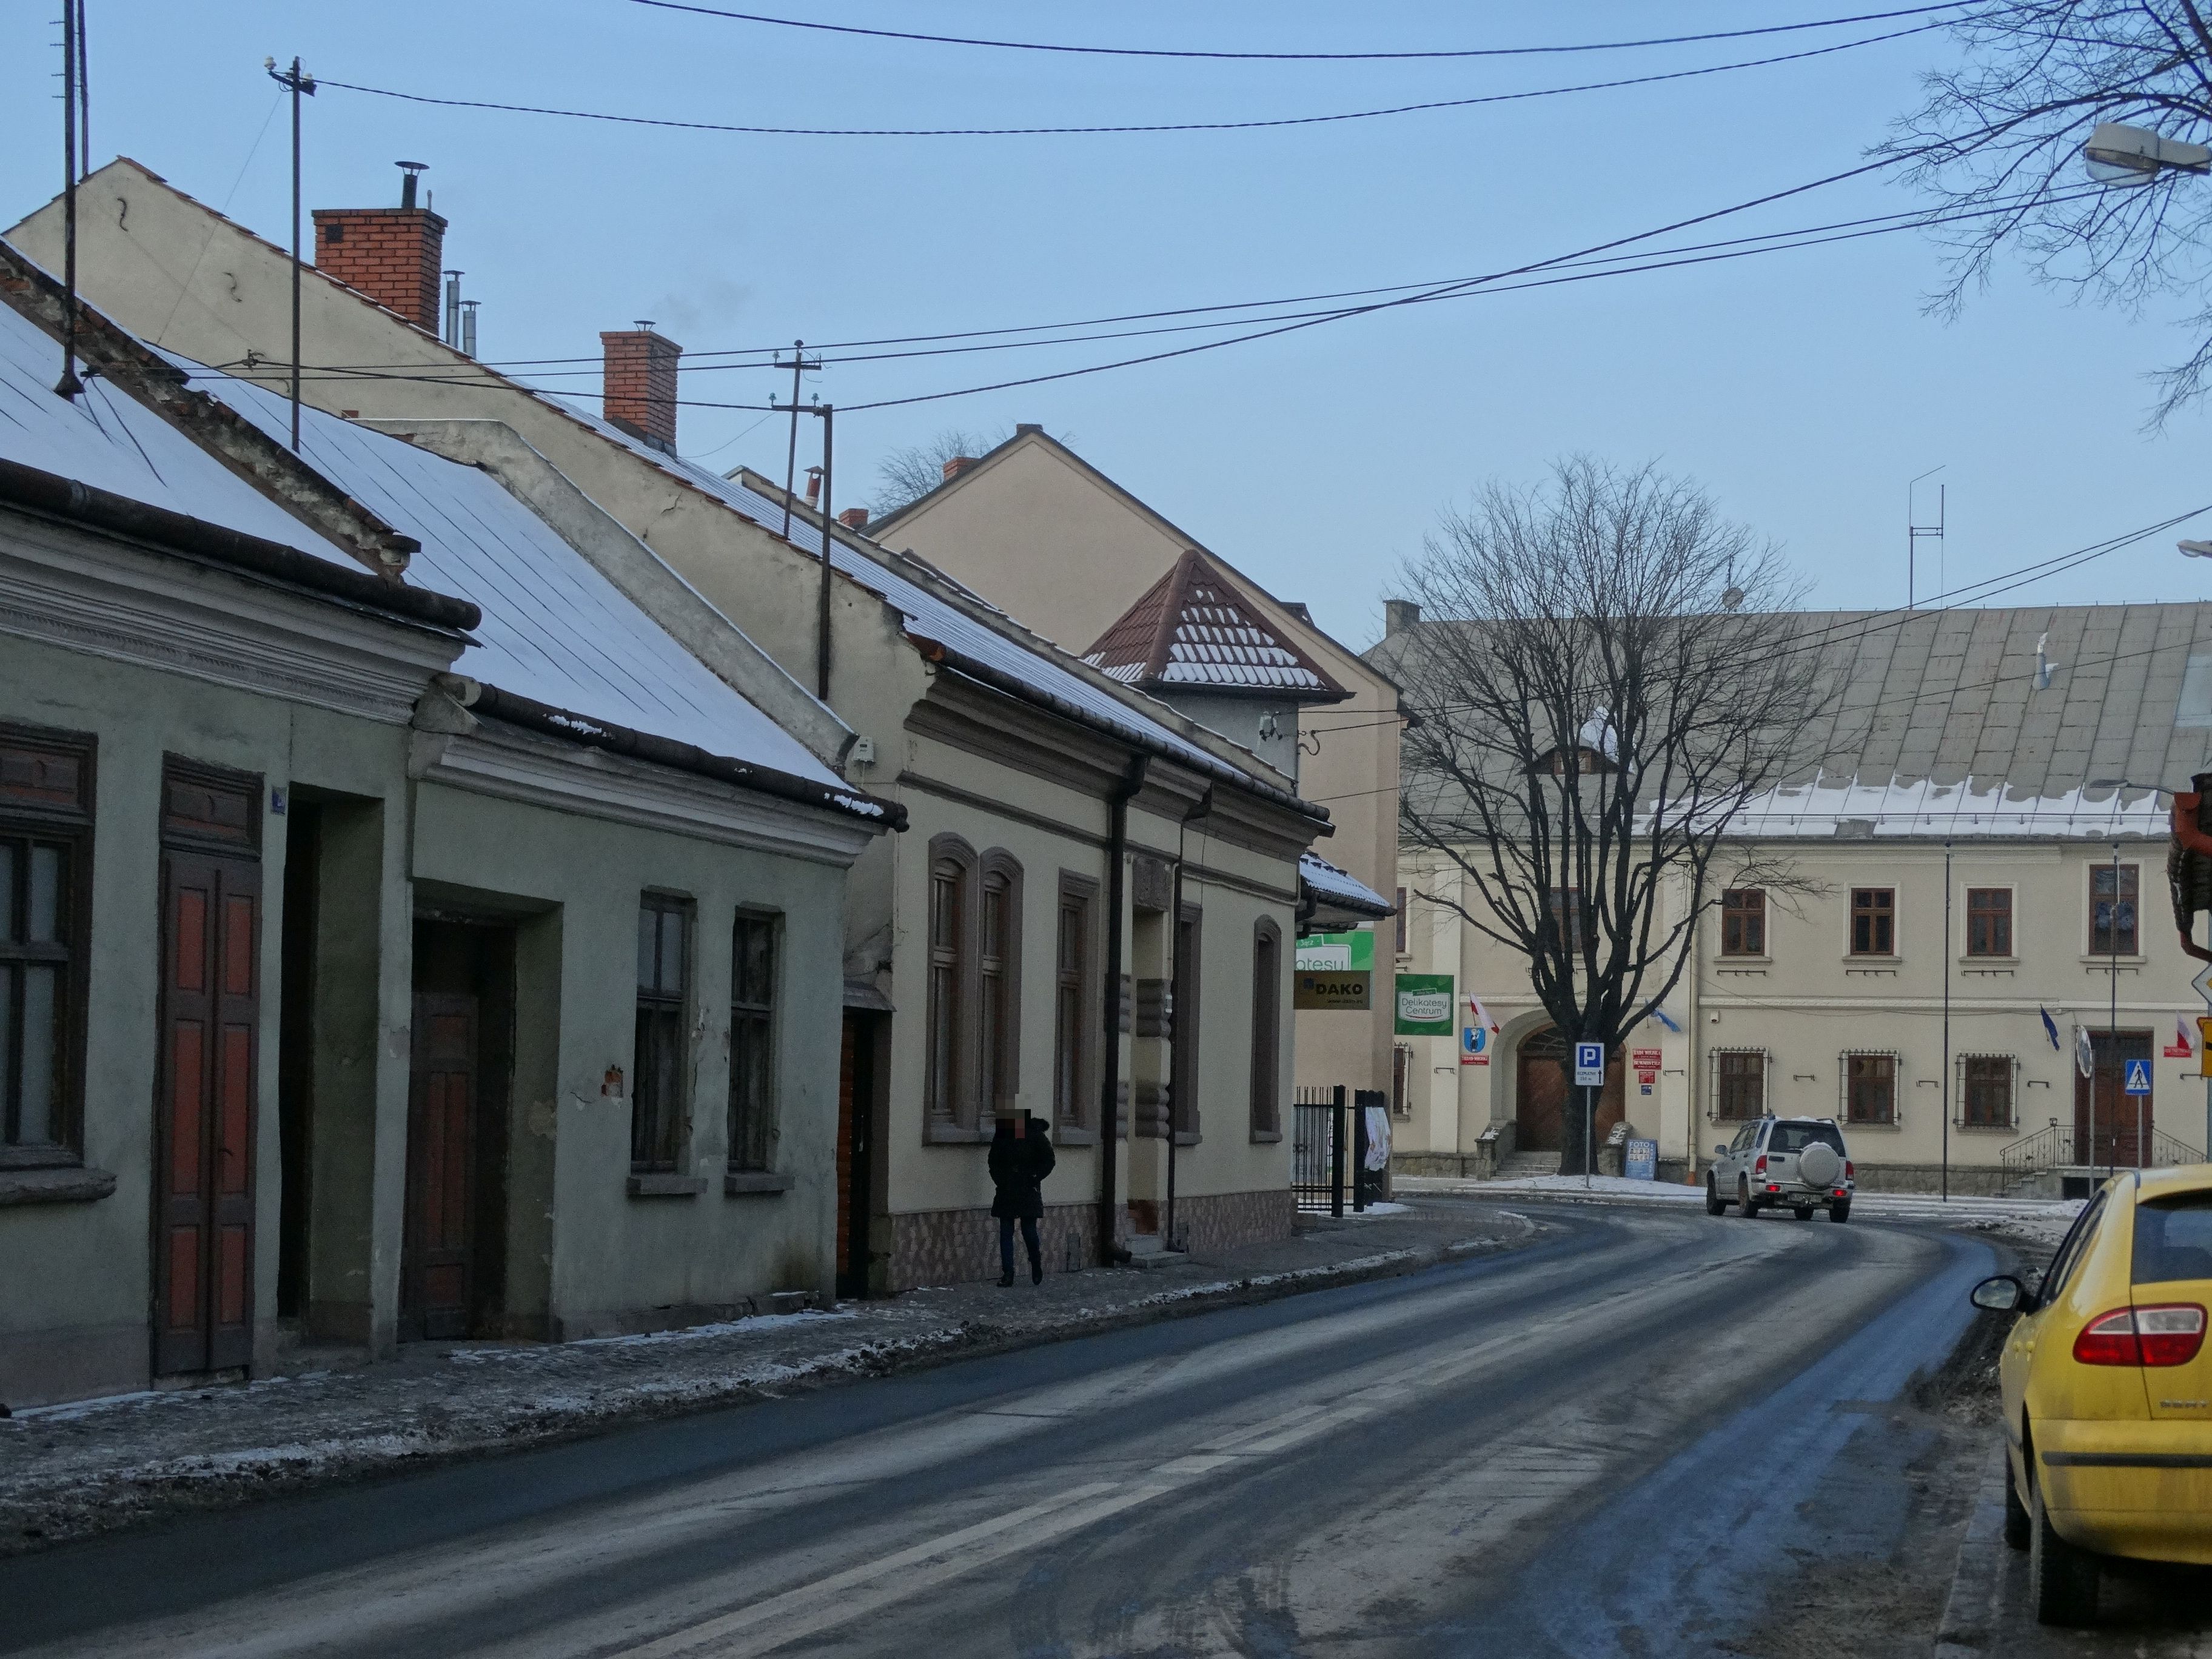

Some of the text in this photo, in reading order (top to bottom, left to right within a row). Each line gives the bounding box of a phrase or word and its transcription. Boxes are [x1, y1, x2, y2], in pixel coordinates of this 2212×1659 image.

[1316, 984, 1363, 995] DAKO
[1402, 997, 1447, 1009] Delikatesy
[1584, 1048, 1596, 1065] P
